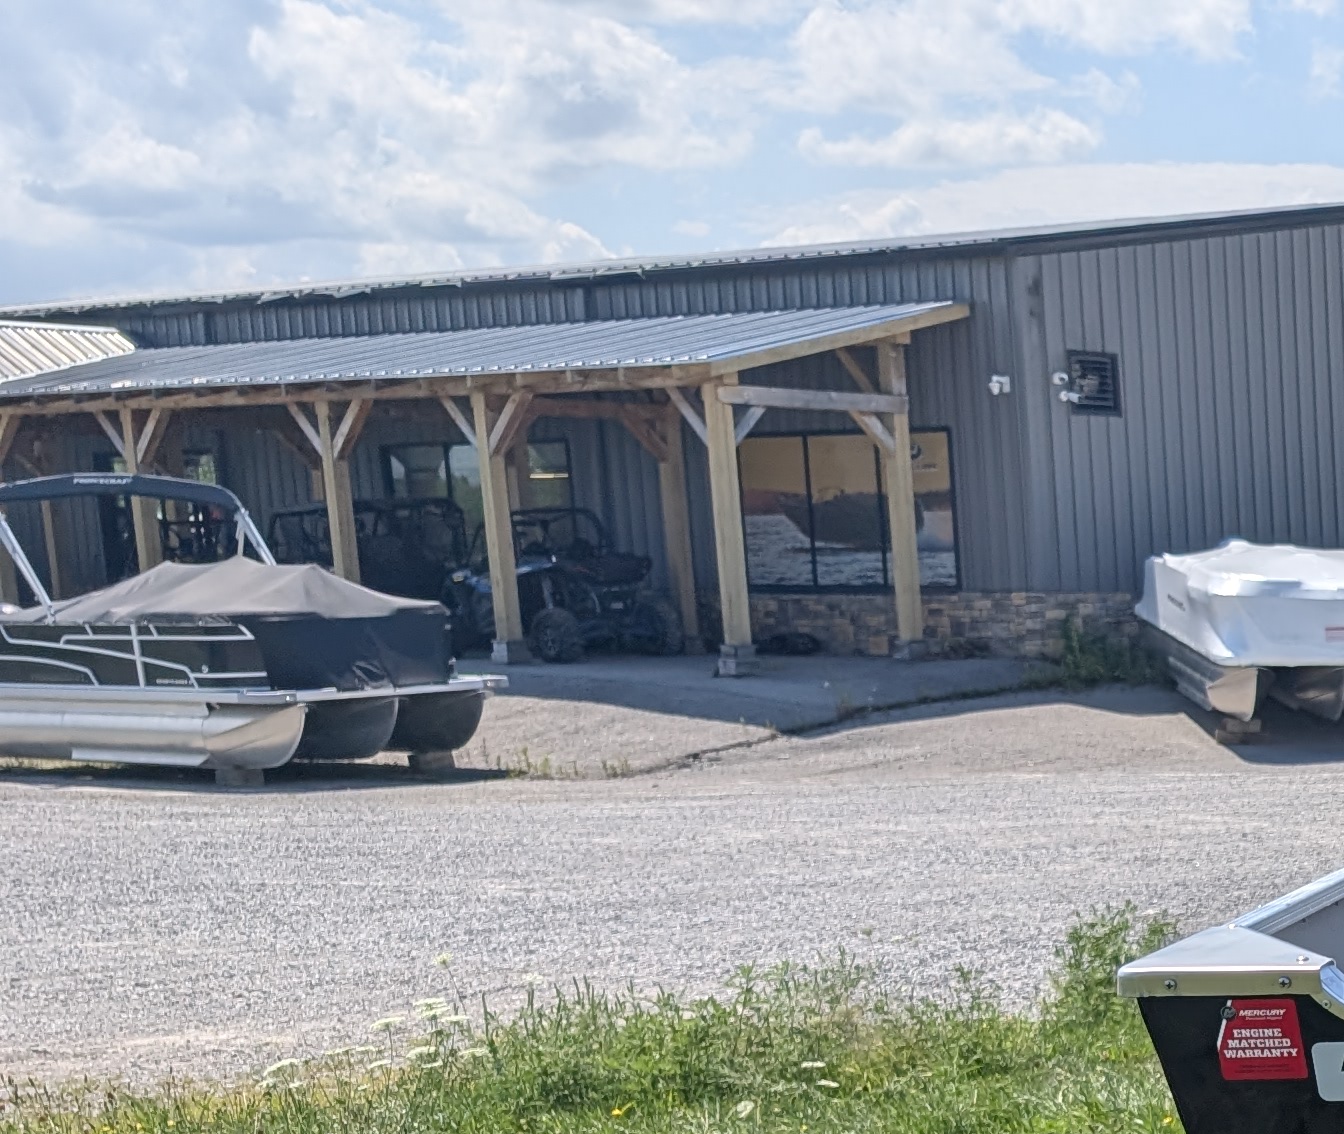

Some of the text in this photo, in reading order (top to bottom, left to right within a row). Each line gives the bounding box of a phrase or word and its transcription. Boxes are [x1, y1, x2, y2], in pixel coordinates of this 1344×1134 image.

[1239, 1008, 1287, 1017] MERCURY
[1232, 1027, 1282, 1038] ENGINE
[1226, 1038, 1291, 1048] MATCHED
[1223, 1048, 1298, 1059] WARRANTY
